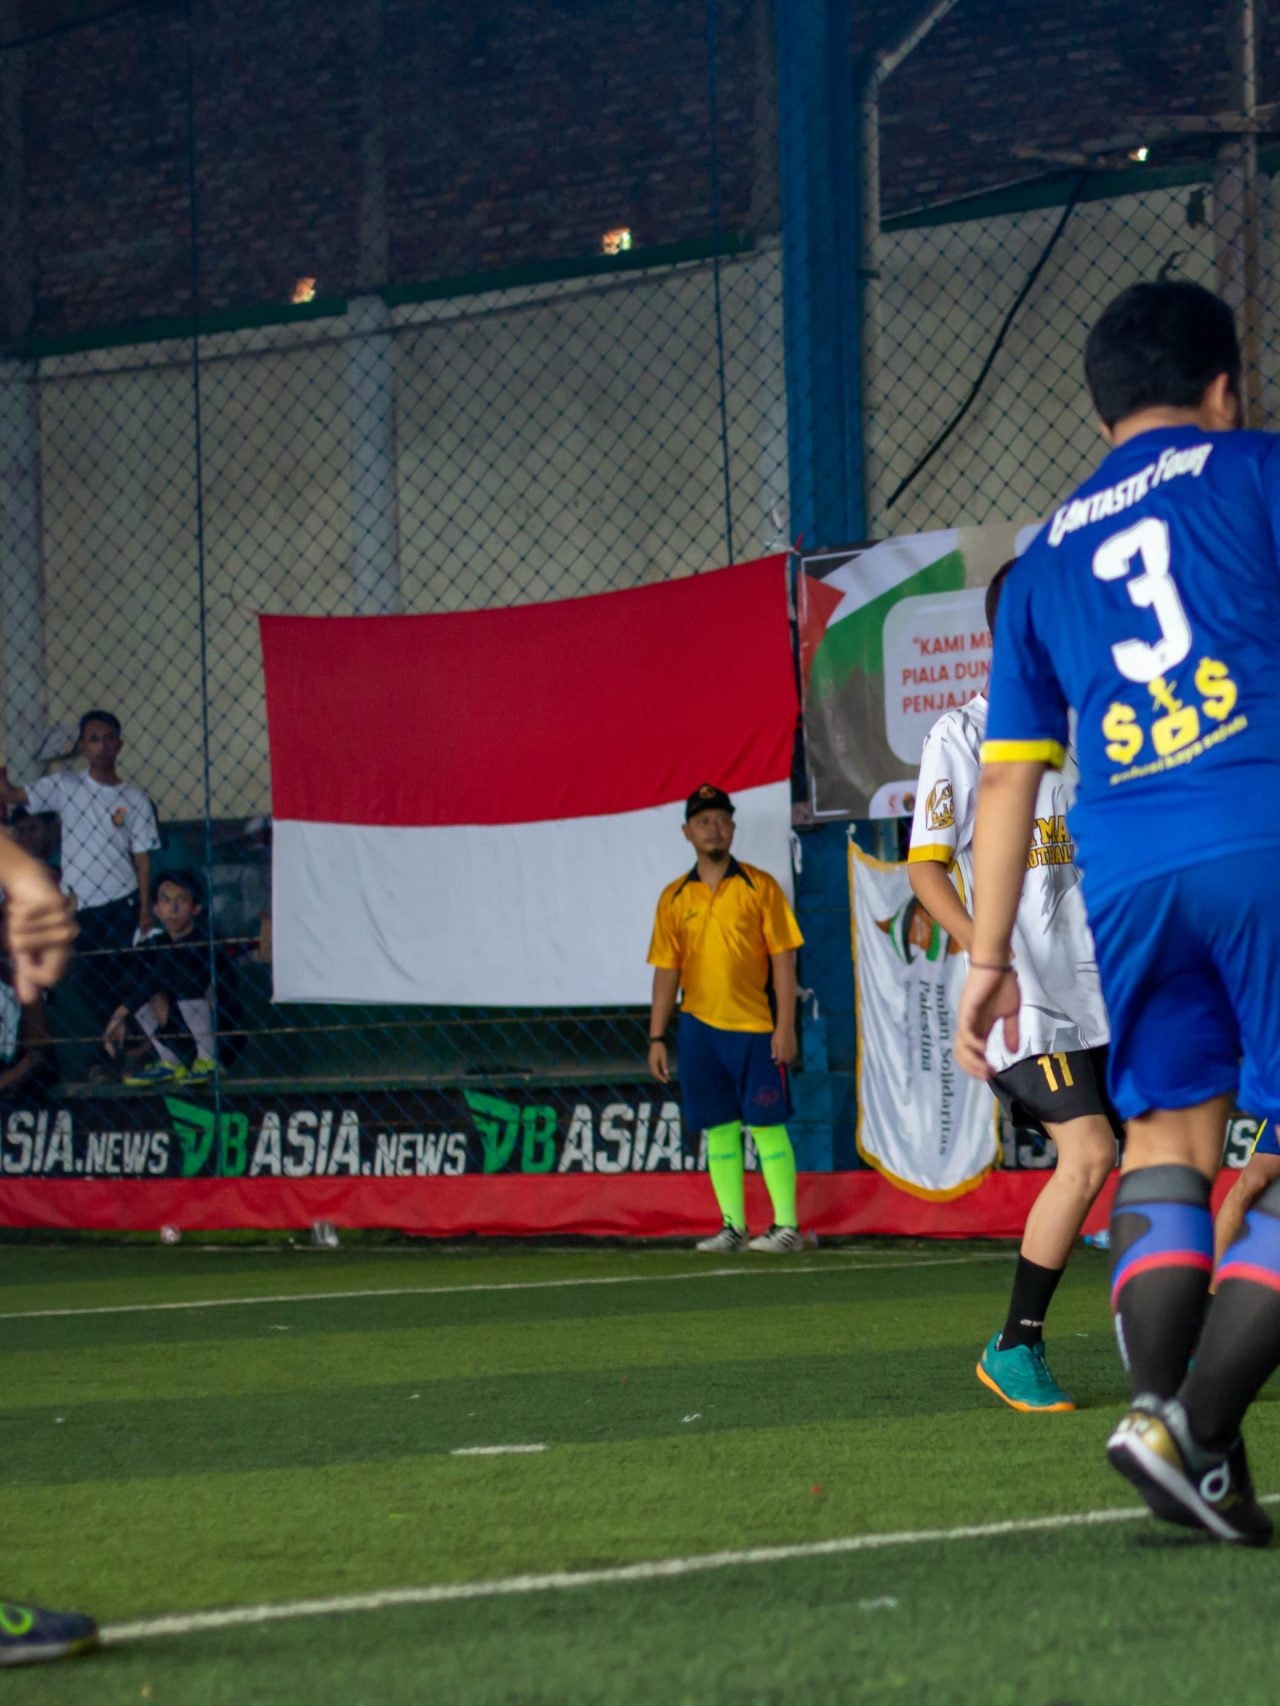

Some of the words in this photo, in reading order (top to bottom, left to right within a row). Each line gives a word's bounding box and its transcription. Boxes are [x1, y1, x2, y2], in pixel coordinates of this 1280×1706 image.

[1093, 517, 1192, 683] 3
[902, 663, 949, 686] PIALA
[1037, 1051, 1074, 1093] 11
[0, 1109, 170, 1174] SIA.NEWS
